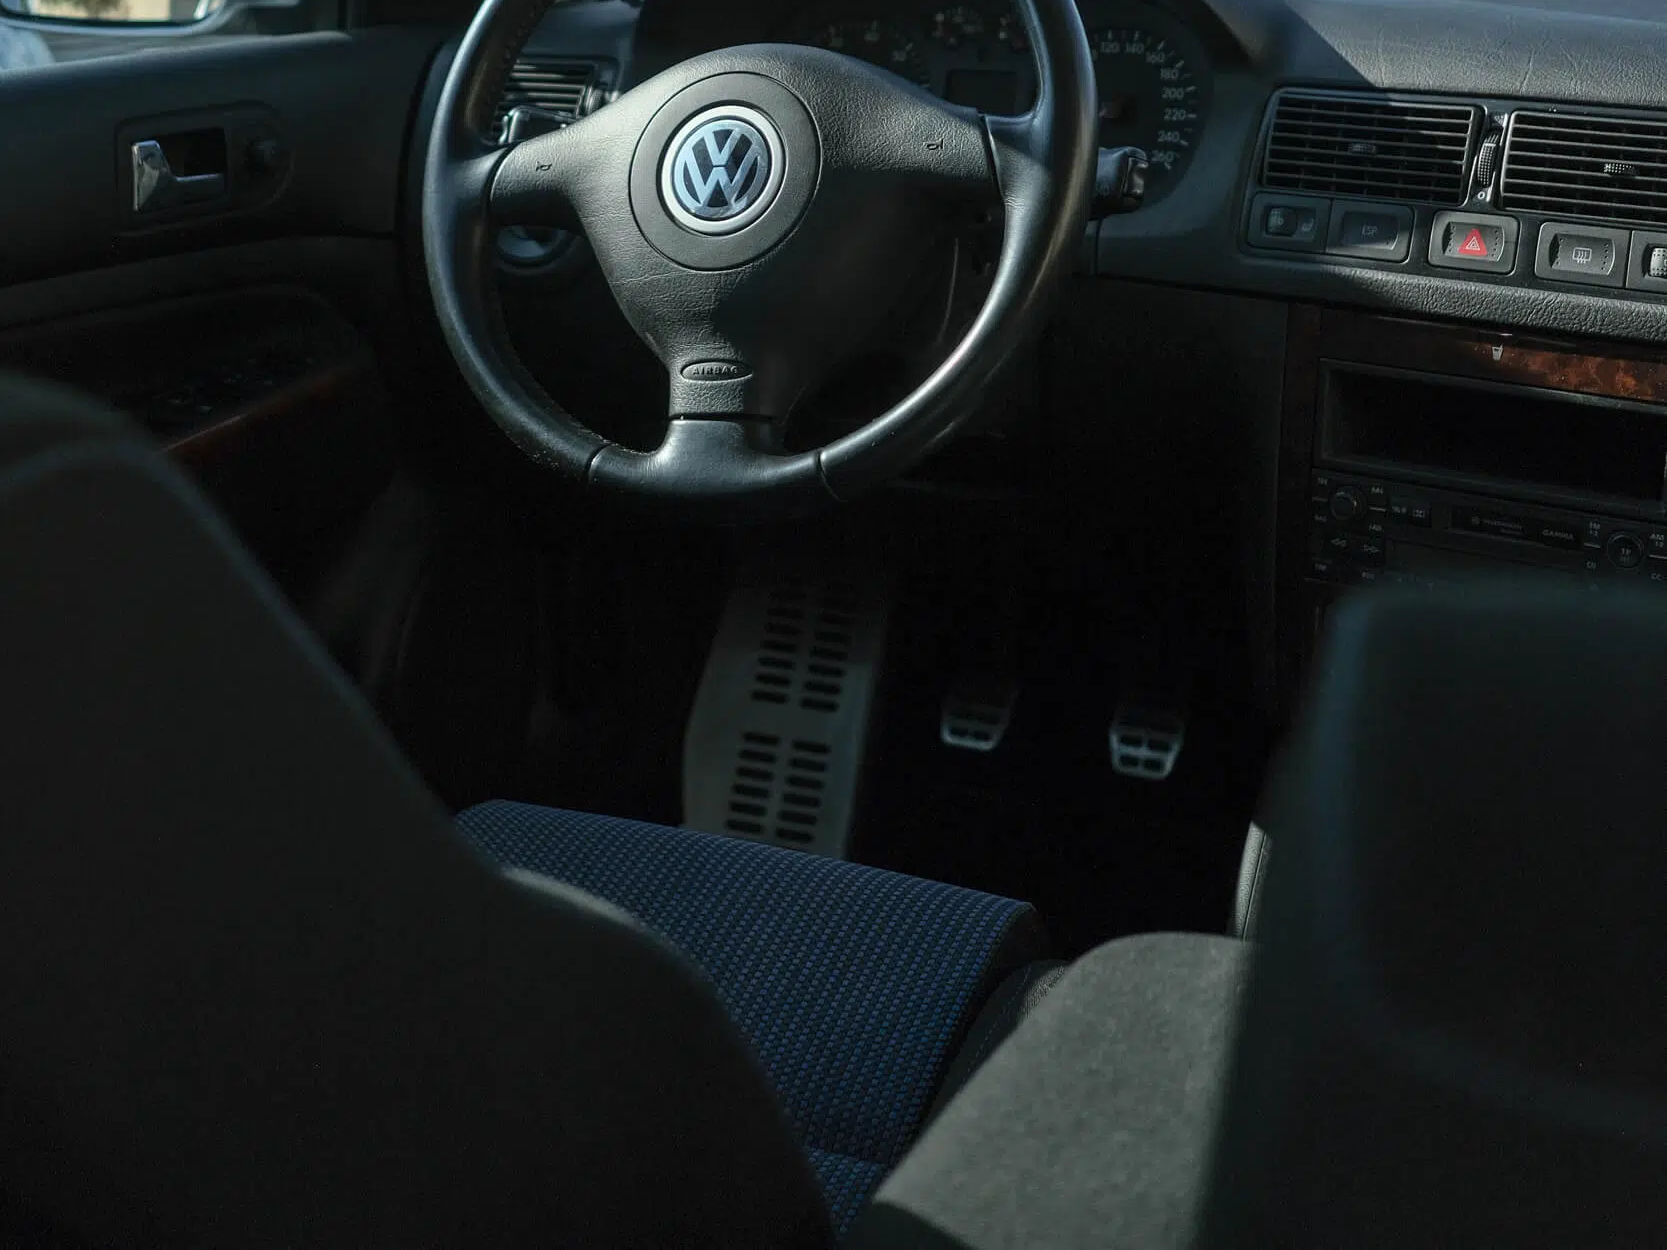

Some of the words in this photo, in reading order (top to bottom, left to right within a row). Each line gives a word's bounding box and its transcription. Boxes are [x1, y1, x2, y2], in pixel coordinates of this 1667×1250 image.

[1101, 41, 1120, 53] 120
[1125, 42, 1145, 54] 140
[1160, 67, 1180, 80] 180
[1161, 87, 1184, 100] 200
[1163, 108, 1187, 121] 220
[1157, 130, 1180, 143] 240
[674, 120, 768, 217] VW
[1361, 224, 1378, 237] ESP
[692, 365, 738, 376] AIRBAG
